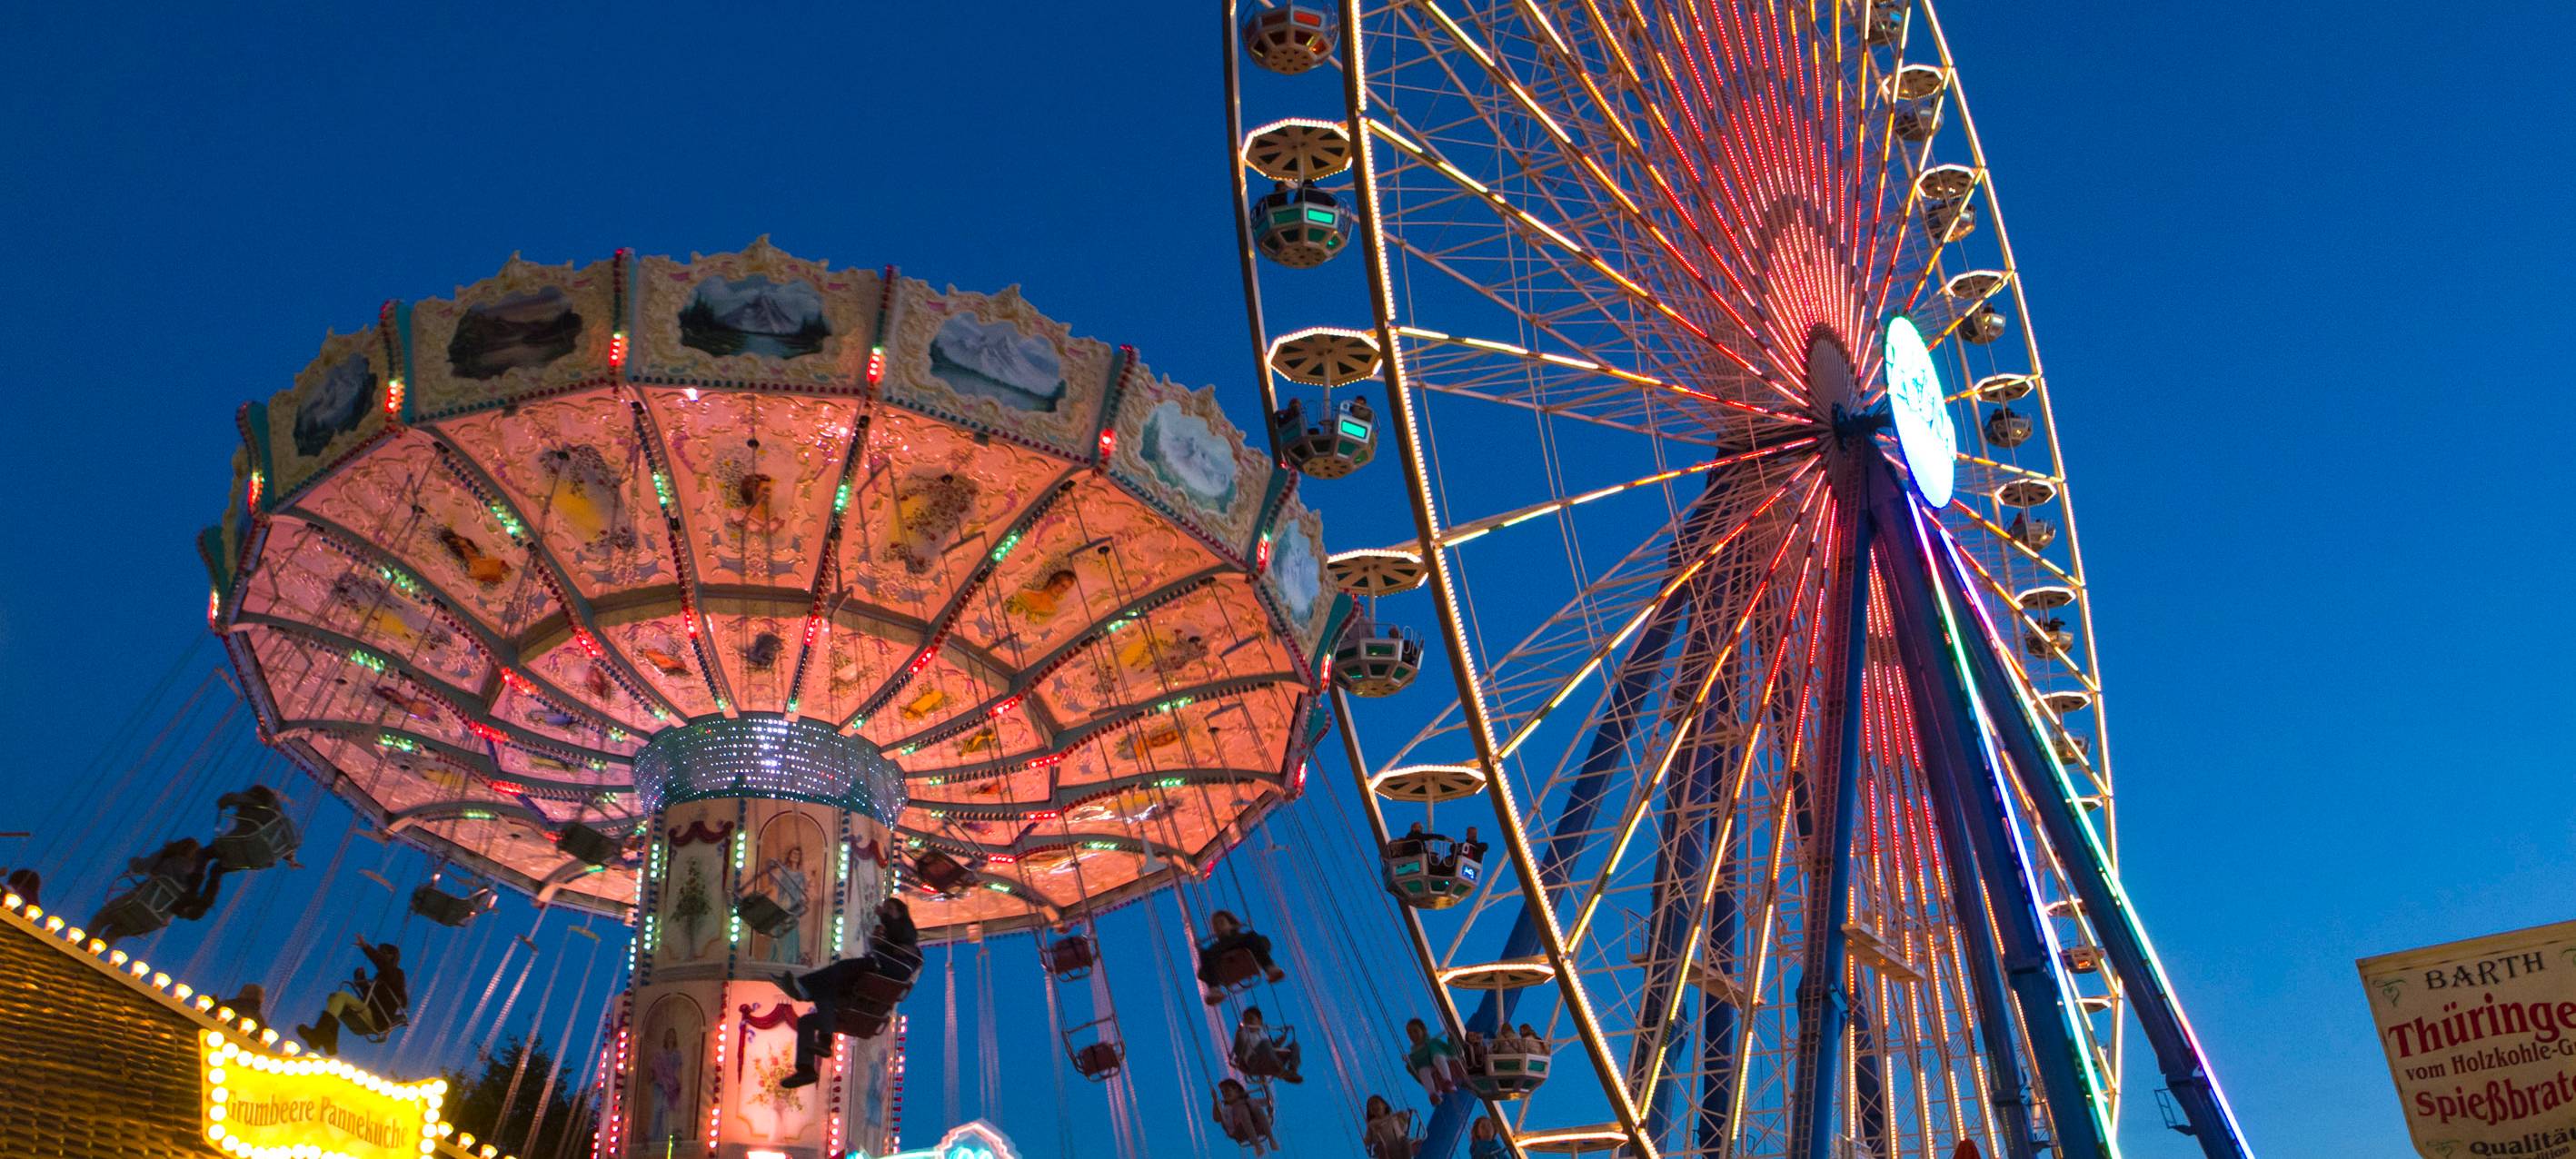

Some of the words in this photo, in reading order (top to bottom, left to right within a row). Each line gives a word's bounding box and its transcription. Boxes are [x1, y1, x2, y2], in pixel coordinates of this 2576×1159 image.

[2424, 951, 2545, 990] BARTH
[2405, 1062, 2447, 1082] vom
[225, 1089, 314, 1126] Grumbeere
[2414, 1069, 2576, 1126] Spießbrat
